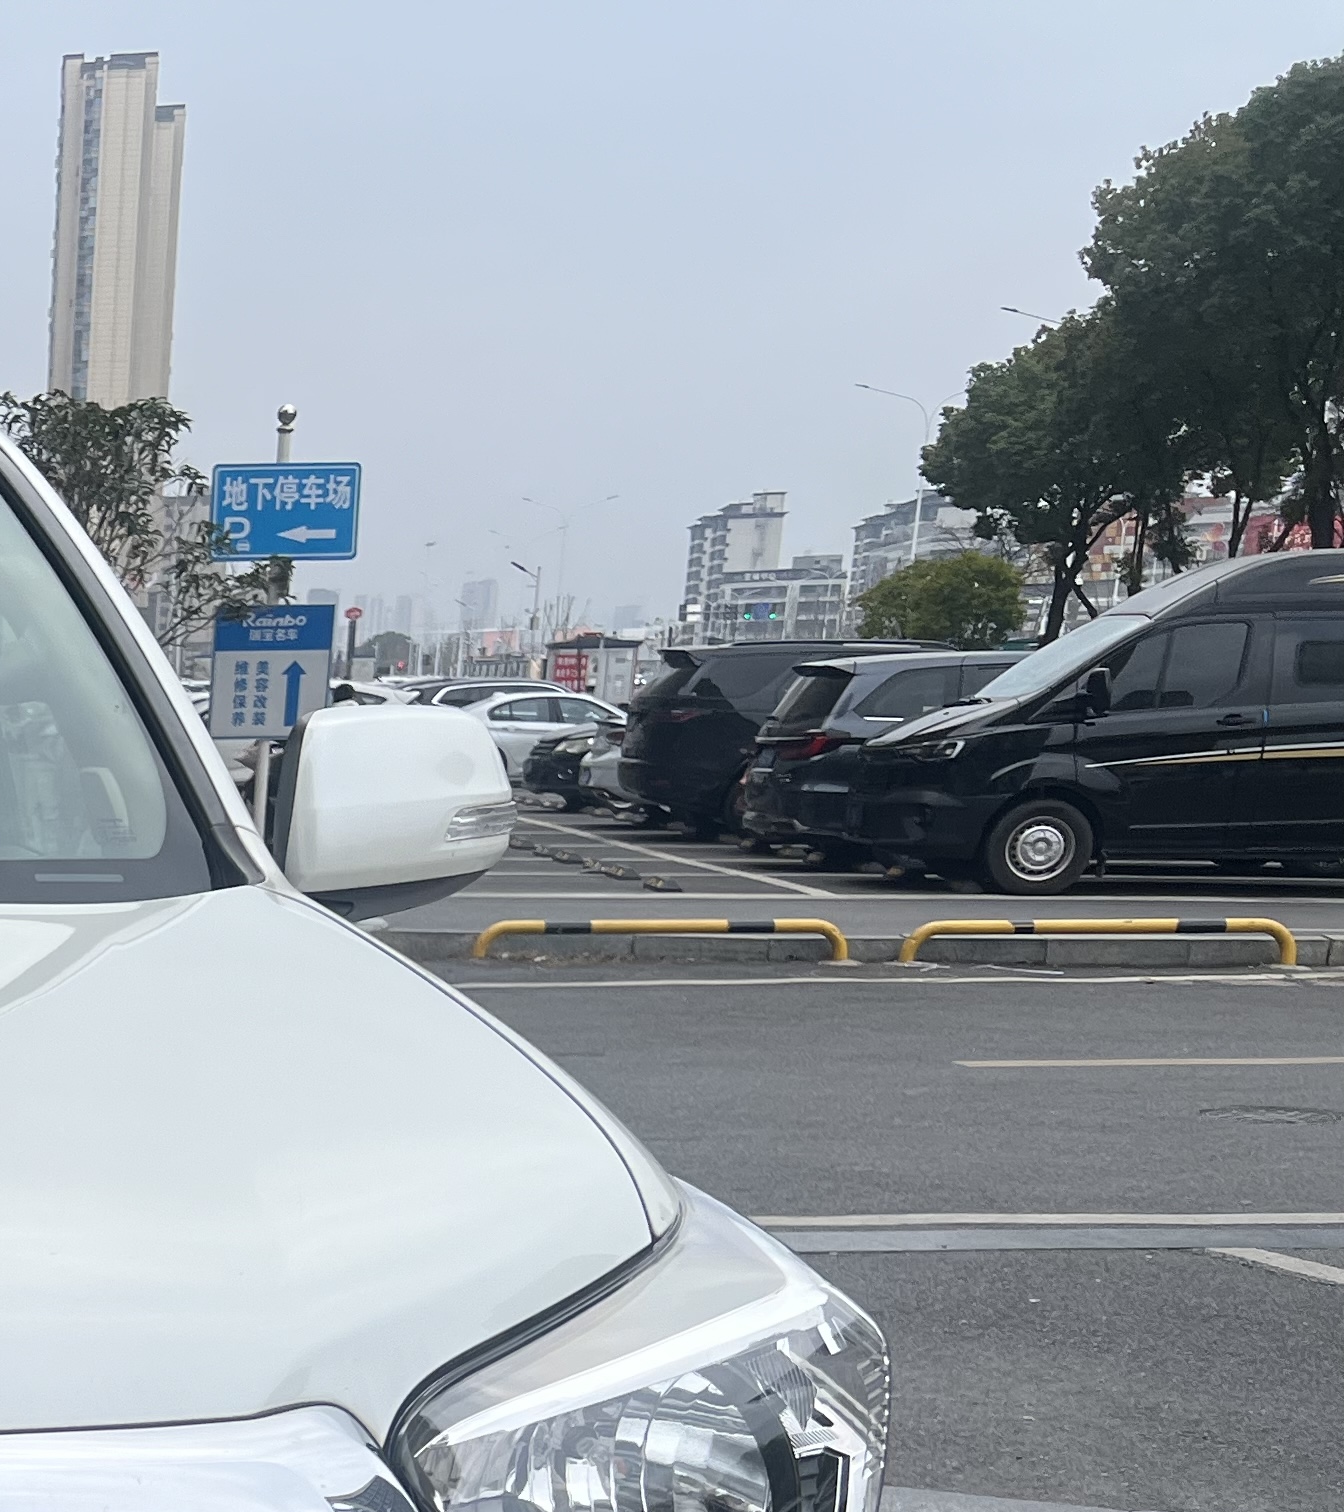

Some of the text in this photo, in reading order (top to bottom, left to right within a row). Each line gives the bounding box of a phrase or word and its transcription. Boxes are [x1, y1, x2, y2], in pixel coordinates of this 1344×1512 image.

[222, 474, 351, 511] 地下停车场
[242, 611, 307, 628] Rainbo
